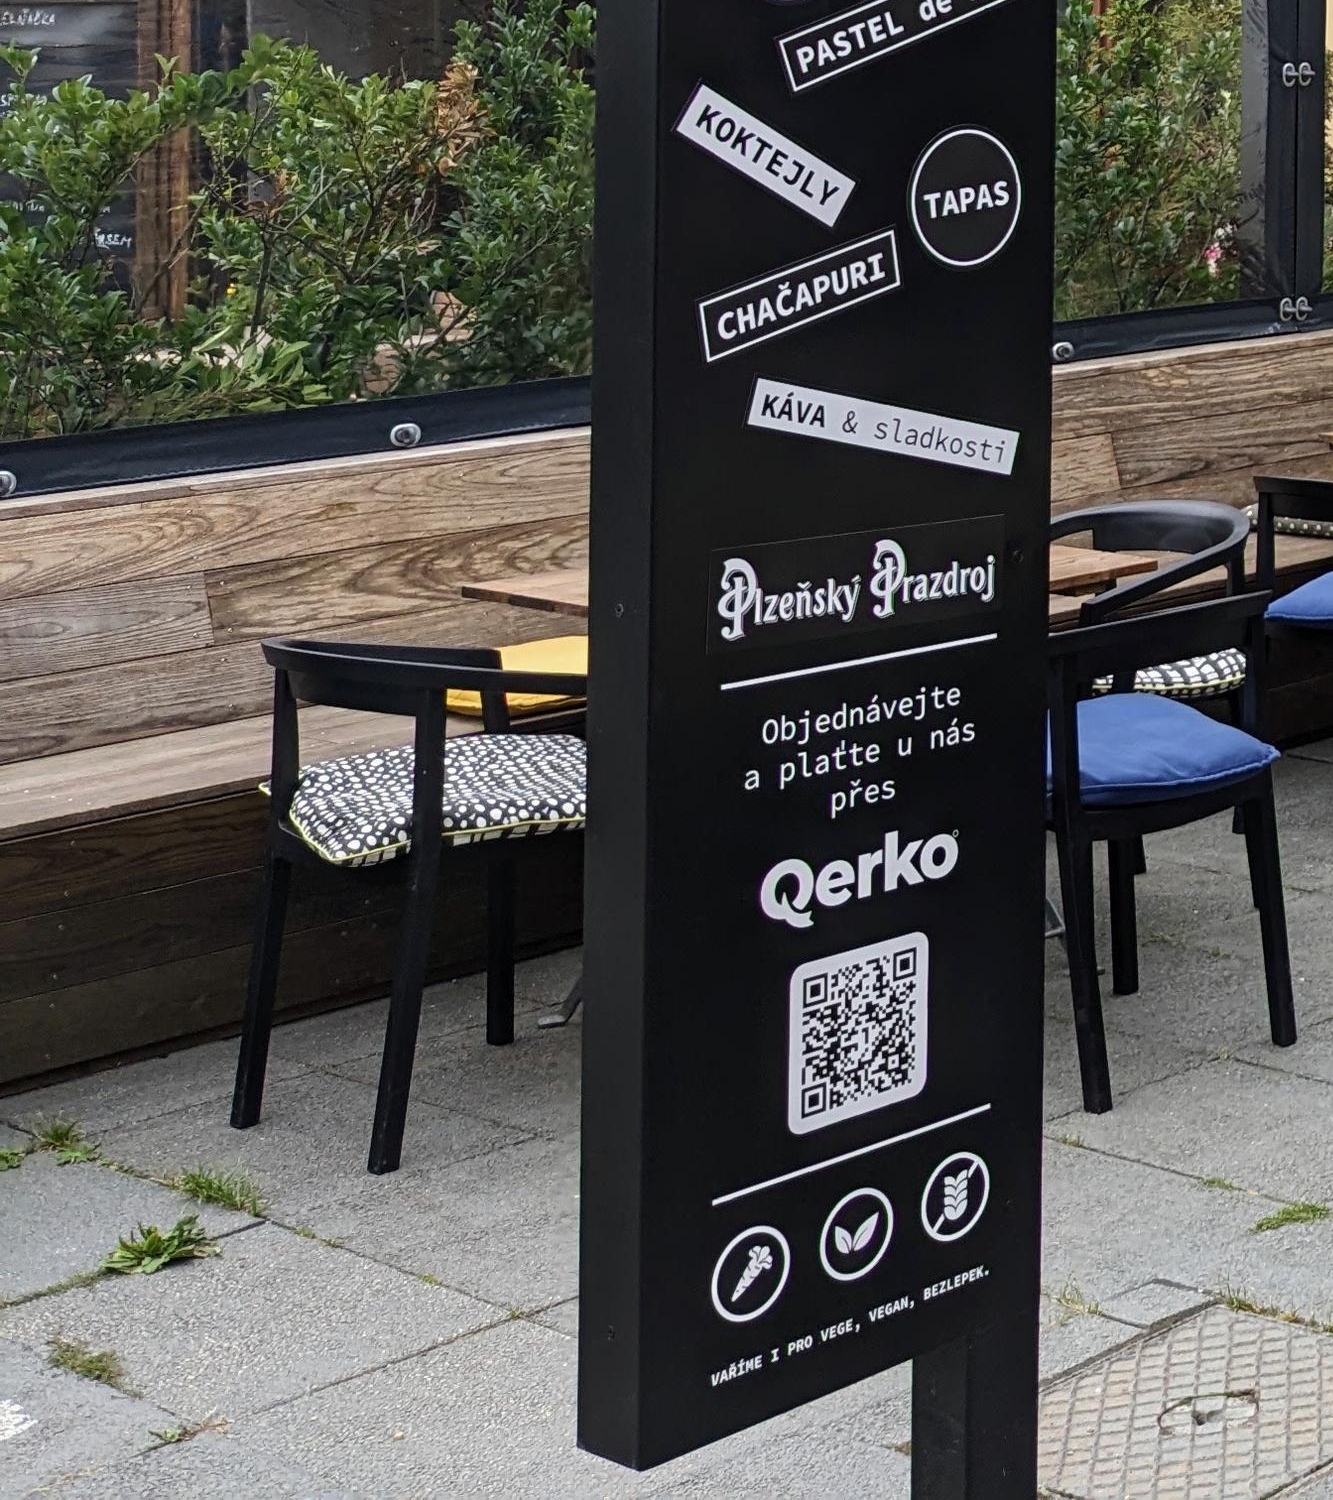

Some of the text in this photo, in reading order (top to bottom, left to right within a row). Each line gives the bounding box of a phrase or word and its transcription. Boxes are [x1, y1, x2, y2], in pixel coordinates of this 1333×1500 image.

[795, 10, 905, 74] PASTEL
[695, 103, 841, 207] KOKTEJLY
[923, 180, 1010, 219] TAPAS
[716, 252, 887, 341] CHAČAPURI
[760, 391, 1007, 464] KÁVA & sladkosti
[717, 538, 996, 641] Plzeňský Prazdroj
[761, 684, 962, 745] Objednávejte
[744, 717, 976, 791] a plaťte u nás
[831, 778, 896, 819] přes
[760, 830, 959, 928] Qerko
[710, 1264, 990, 1387] VAŘÍME I PRO VEGE, VEGAN, BEZLEPEK.
